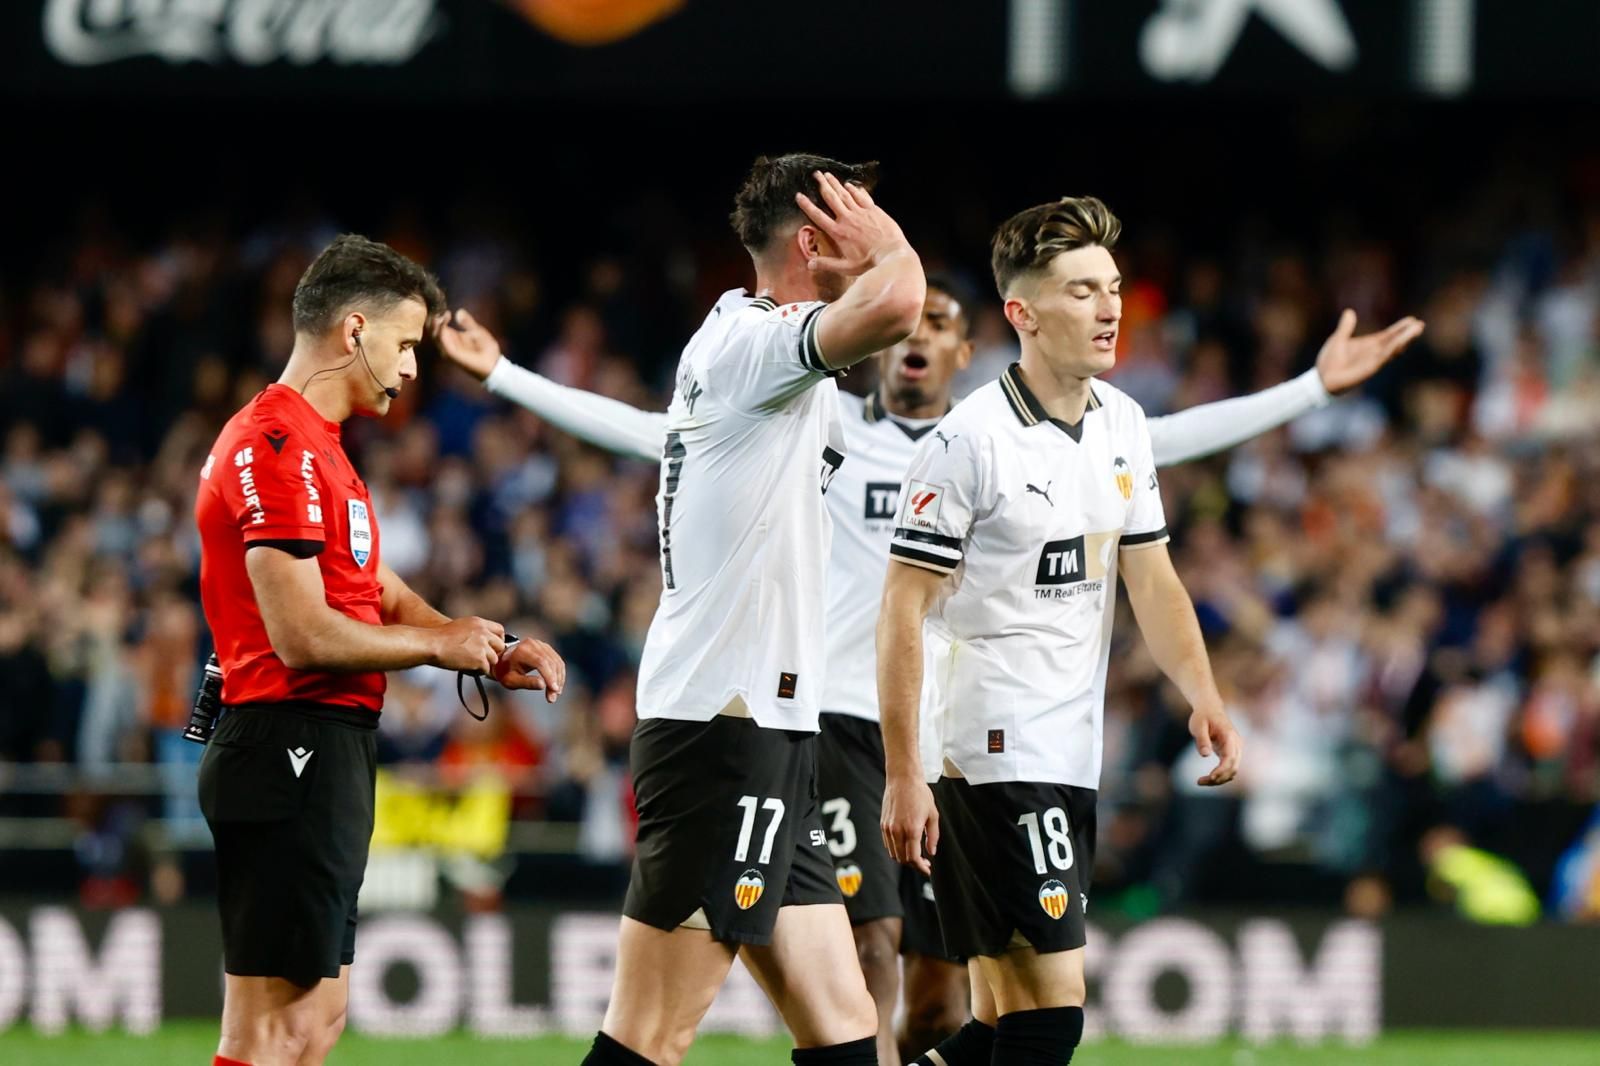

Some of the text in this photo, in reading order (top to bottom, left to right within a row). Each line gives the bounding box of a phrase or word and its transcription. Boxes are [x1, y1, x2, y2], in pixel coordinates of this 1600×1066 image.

[1046, 548, 1079, 577] TM
[1034, 588, 1052, 600] TM
[733, 795, 786, 865] 17
[821, 796, 857, 858] 3
[1017, 806, 1075, 875] 18
